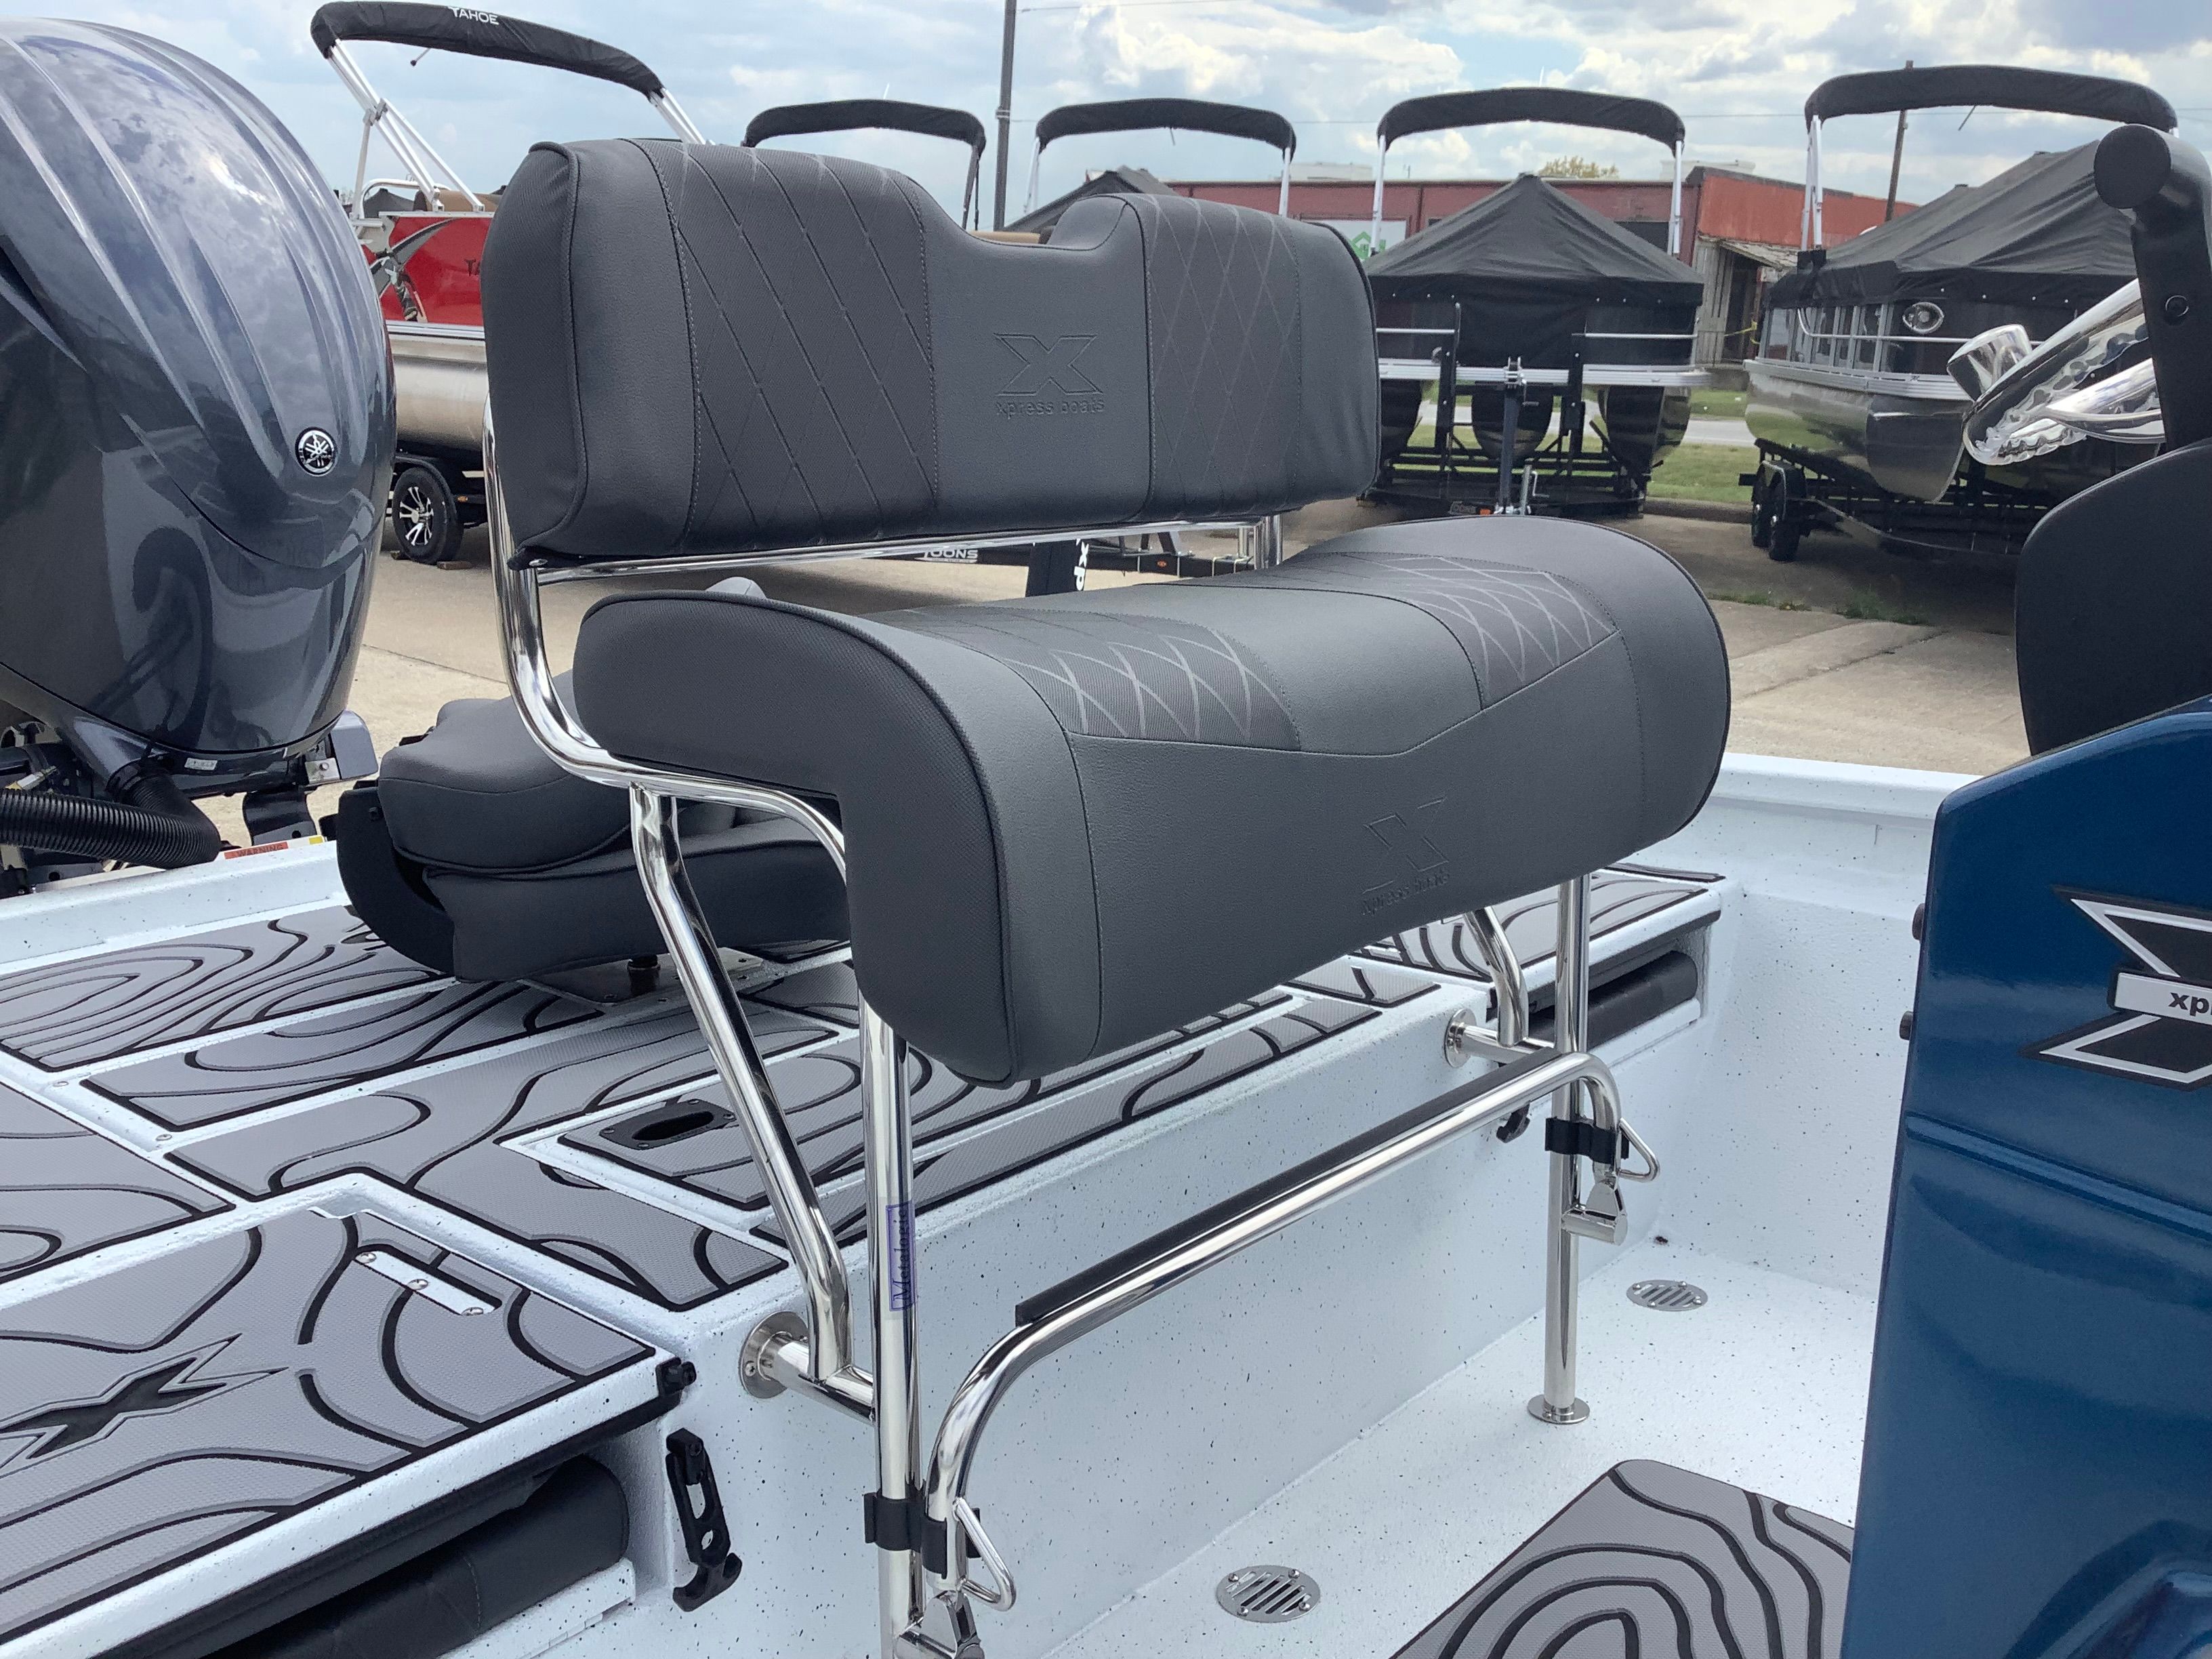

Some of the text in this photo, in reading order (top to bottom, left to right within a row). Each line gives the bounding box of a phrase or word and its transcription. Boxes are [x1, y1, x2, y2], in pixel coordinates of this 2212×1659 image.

[447, 6, 499, 25] TAHOE
[236, 843, 284, 857] WARNING
[2168, 992, 2212, 1017] xp
